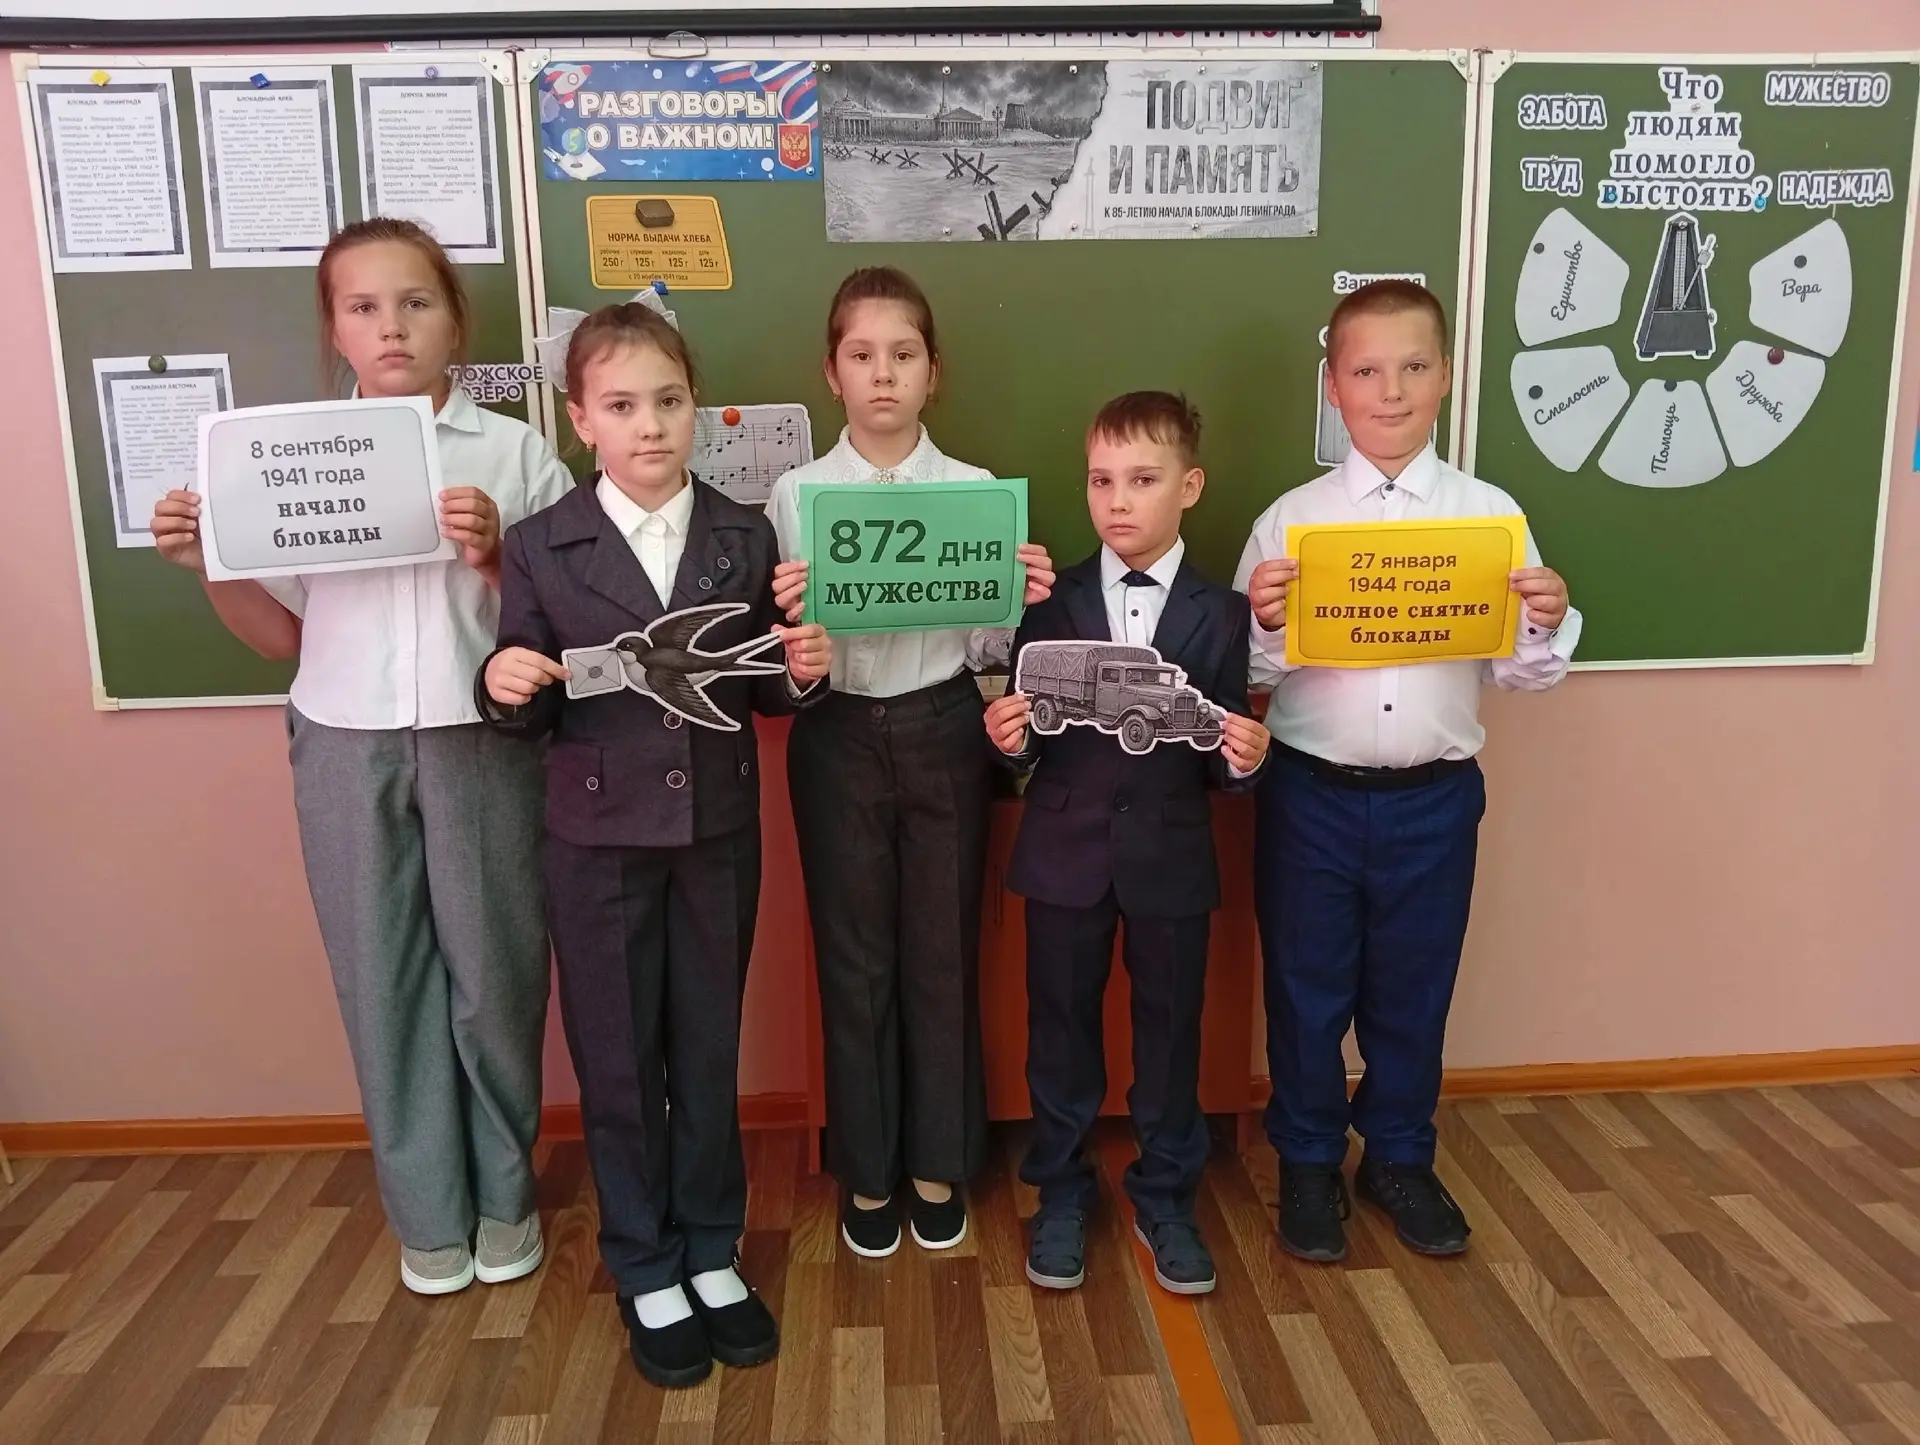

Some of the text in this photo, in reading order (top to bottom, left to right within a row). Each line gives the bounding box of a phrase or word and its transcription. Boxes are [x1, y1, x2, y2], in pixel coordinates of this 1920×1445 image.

[1662, 72, 1719, 99] Что
[1768, 74, 1889, 104] МУЖЕСТВО
[579, 91, 777, 118] РАЗГОВОРЫ
[1146, 80, 1303, 134] ПОДВИГ
[1520, 97, 1606, 127] ЗАБОТА
[587, 124, 775, 150] О ВАЖНОМ!
[1109, 143, 1300, 194] И ПАМЯТЬ
[1522, 160, 1582, 194] ТРУД
[1779, 171, 1891, 205] НАДЕЖДА
[1104, 204, 1296, 218] К 85-ЛЕТИЮ НАЧАЛА БЛОКАДЫ ЛЕНИНГРАДА
[608, 233, 712, 244] НОРМА ВЫДАЧИ ХЛЕБА
[603, 257, 619, 267] 250
[635, 257, 651, 267] 125
[668, 258, 684, 268] 125
[699, 258, 714, 268] 125
[1551, 240, 1584, 322] Единство
[1781, 278, 1822, 303] Вера
[451, 365, 544, 384] ДОЖСКОЕ
[1534, 375, 1610, 426] Смелость
[1735, 370, 1783, 423] Дружба
[251, 434, 374, 459] 8 сентября
[1650, 402, 1680, 475] Помощь
[261, 467, 366, 488] 1941 года
[278, 497, 366, 518] начало
[273, 525, 383, 549] блокады
[829, 519, 1002, 567] 872 дня
[1351, 553, 1457, 572] 27 января
[825, 579, 1001, 612] мужества
[1348, 577, 1451, 595] 1944 года
[1315, 602, 1491, 619] полное снятие
[1350, 627, 1451, 645] блокады
